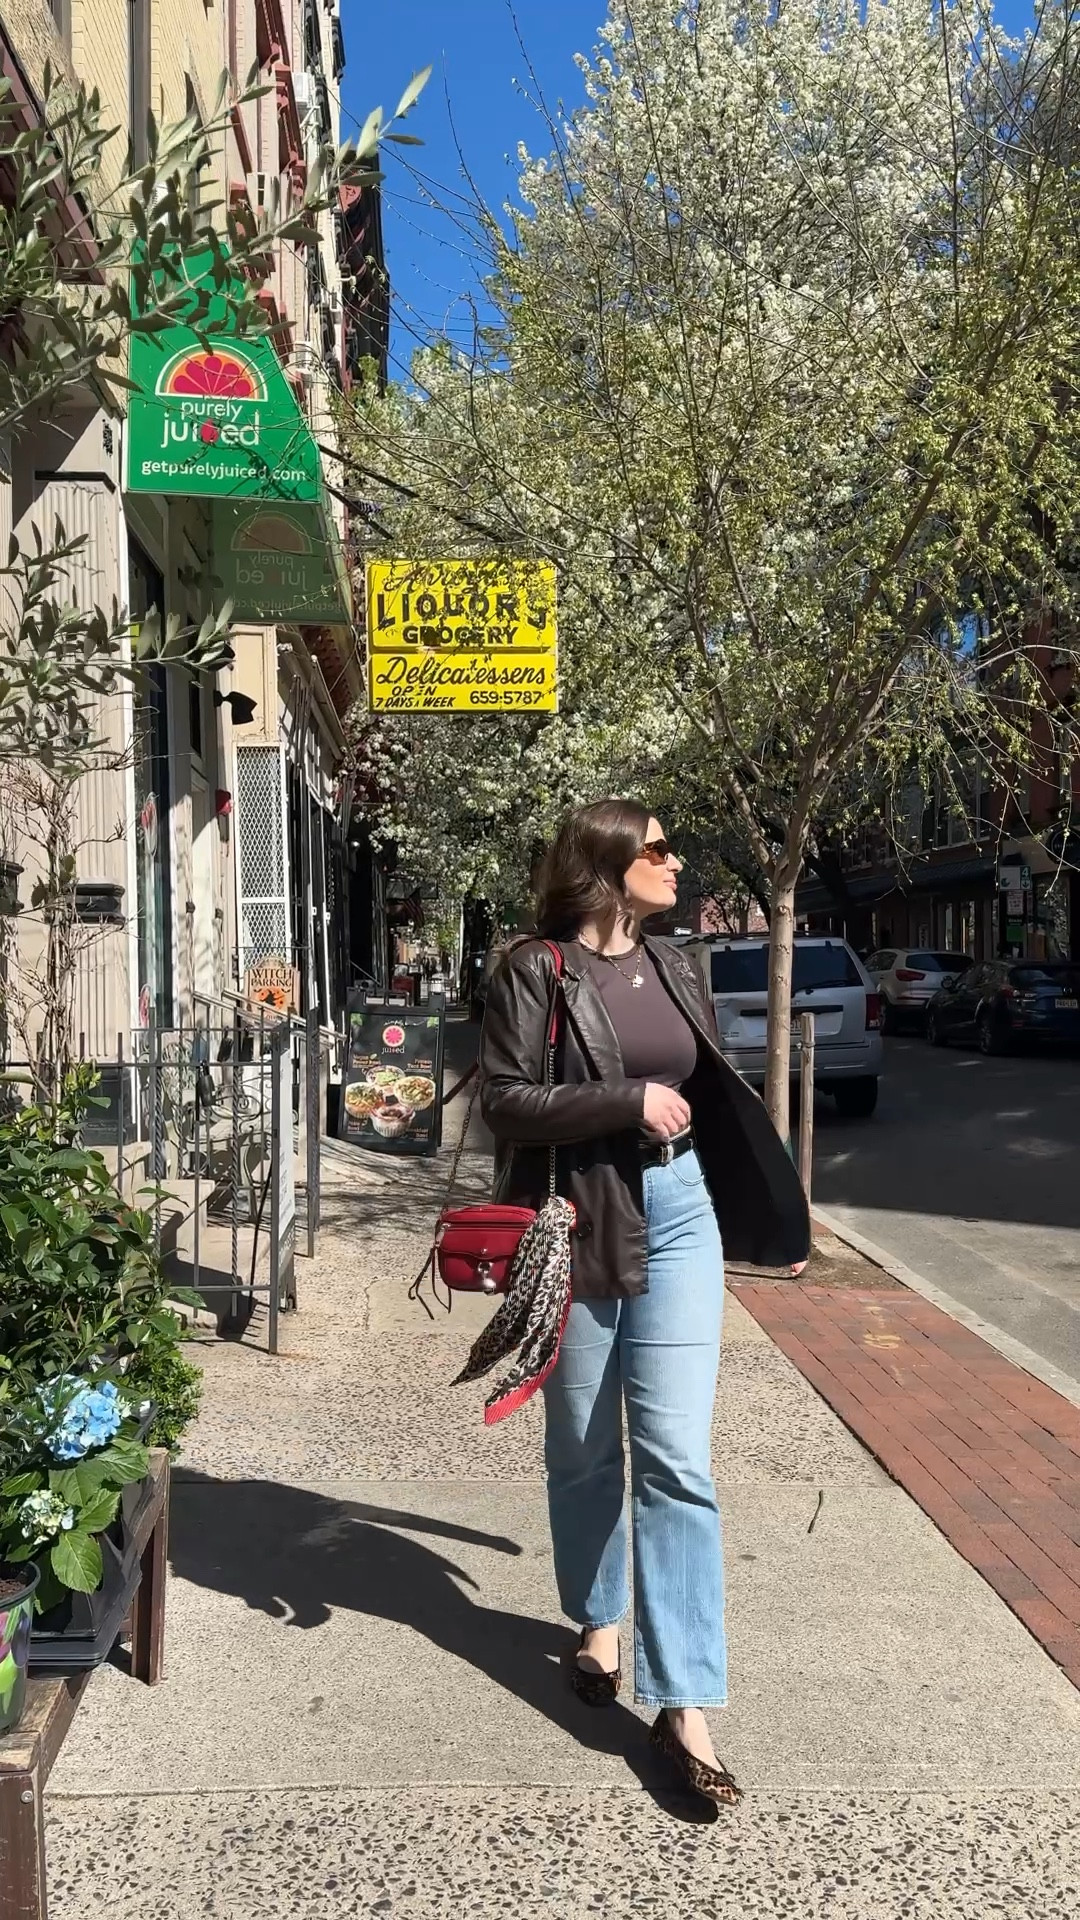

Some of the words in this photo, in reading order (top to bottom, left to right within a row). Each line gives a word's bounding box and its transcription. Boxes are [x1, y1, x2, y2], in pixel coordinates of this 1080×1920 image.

[181, 399, 243, 422] purely
[141, 460, 306, 482] getpurelyjuiced.com
[376, 656, 545, 685] Delicatessens
[391, 685, 437, 696] OPEN
[375, 697, 384, 708] 7
[384, 697, 415, 708] DAYS
[423, 697, 456, 708] WEEK
[252, 968, 292, 979] WITCH
[251, 978, 292, 987] PARKING
